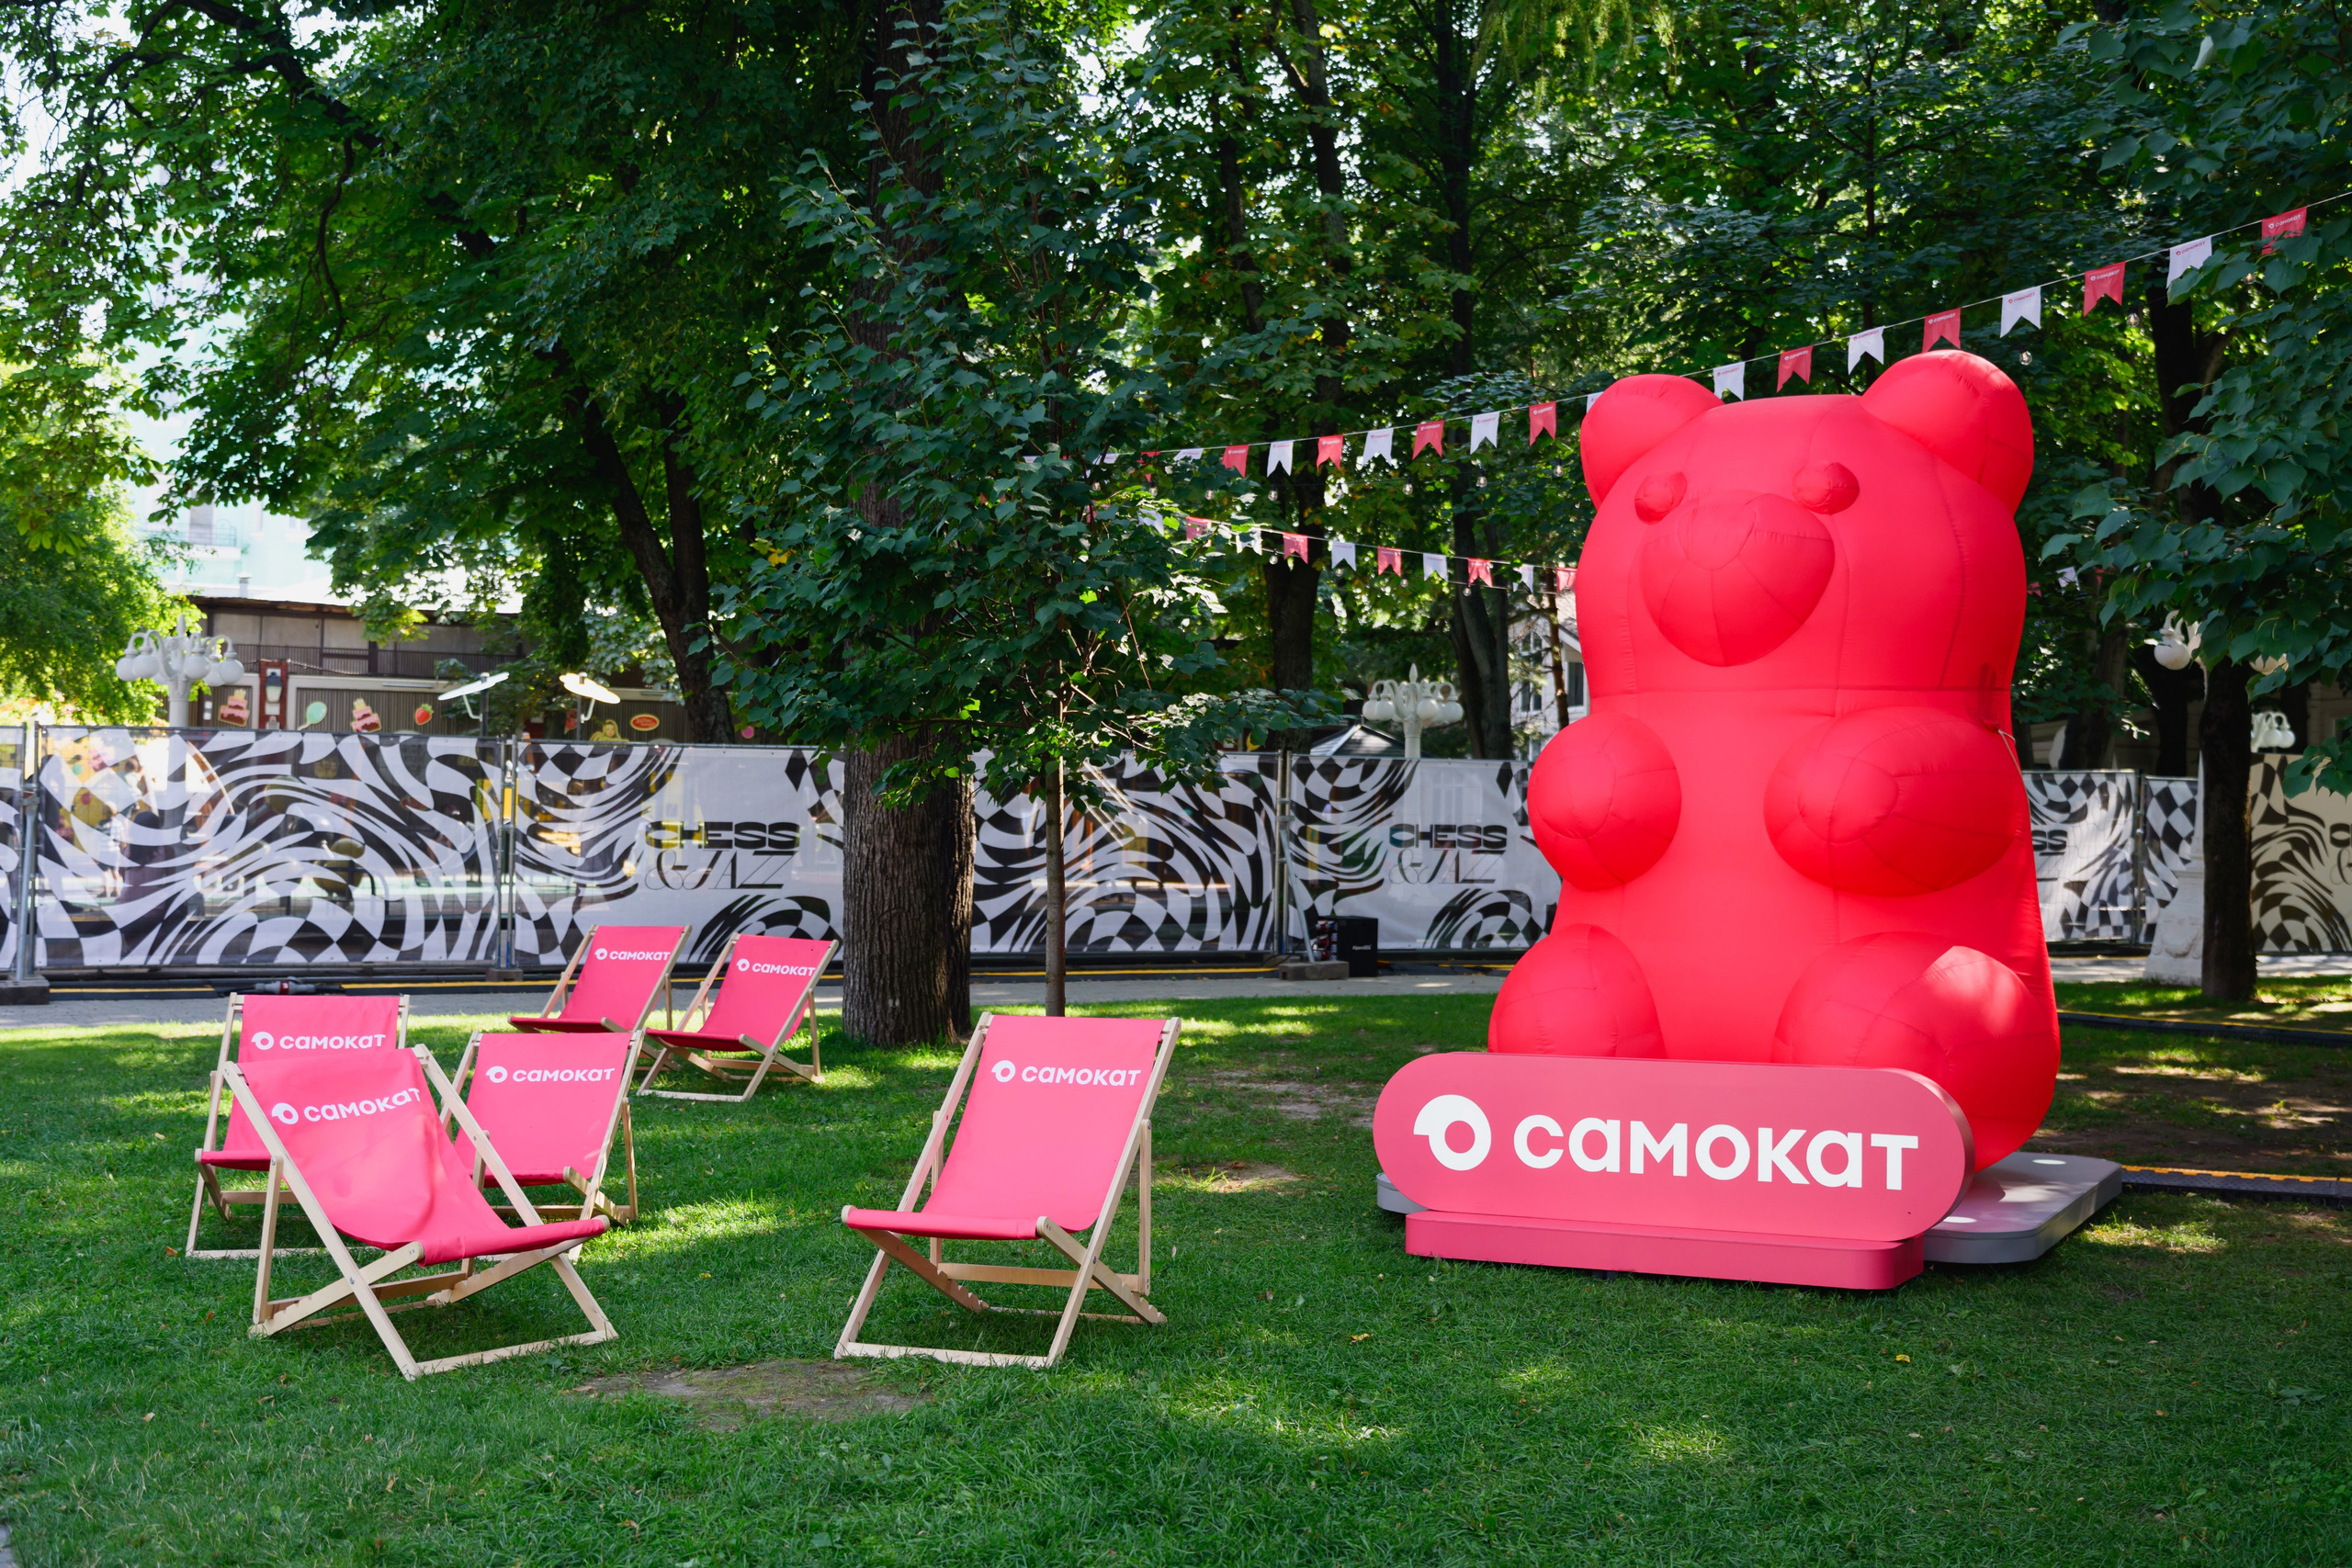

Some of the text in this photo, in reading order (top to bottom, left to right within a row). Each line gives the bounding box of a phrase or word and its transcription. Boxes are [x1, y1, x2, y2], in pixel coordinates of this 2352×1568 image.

[2275, 214, 2301, 227] самокат
[646, 820, 800, 850] CHESS
[1389, 823, 1508, 849] CHESS
[609, 950, 671, 961] самокат
[752, 963, 816, 976] самокат
[278, 1034, 387, 1050] самокат
[512, 1067, 616, 1083] самокат
[1021, 1066, 1142, 1087] самокат
[303, 1088, 421, 1122] самокат
[1513, 1114, 1919, 1190] самокат
